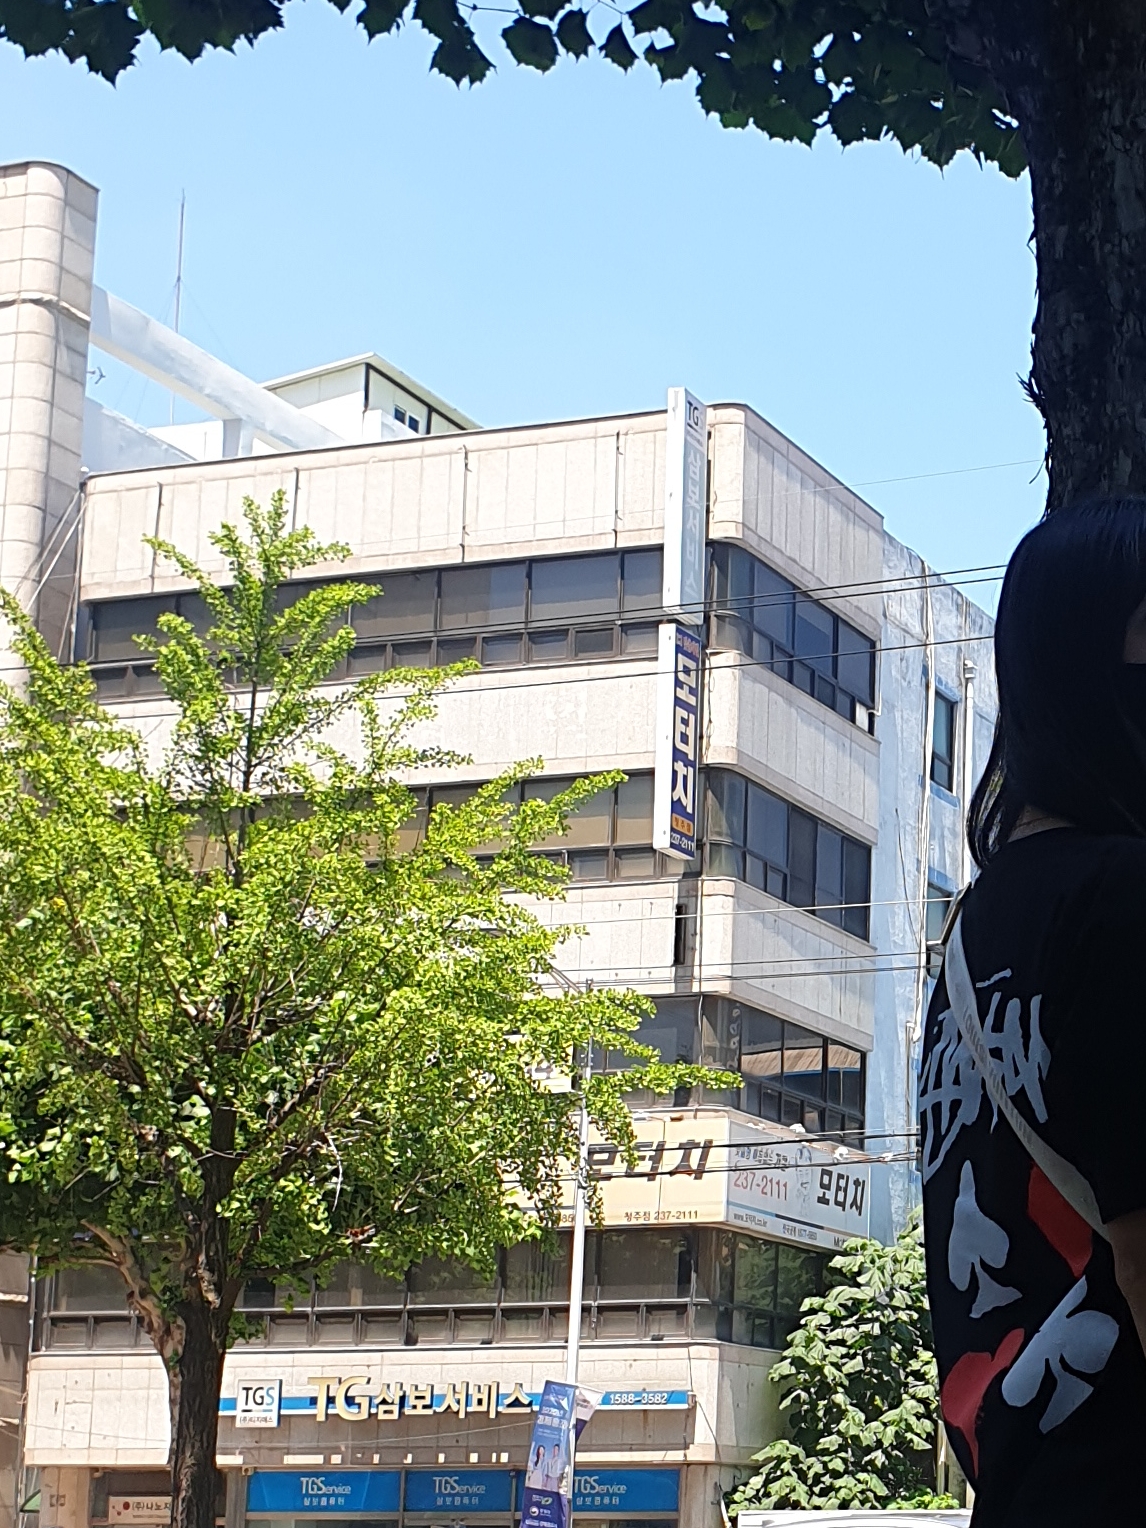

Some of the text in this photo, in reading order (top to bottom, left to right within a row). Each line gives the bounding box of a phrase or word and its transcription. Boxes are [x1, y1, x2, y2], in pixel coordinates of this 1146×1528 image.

[672, 652, 697, 814] 모터치
[671, 831, 694, 852] 237-2111
[733, 1170, 788, 1201] 237-2111
[816, 1168, 866, 1216] 모터치
[624, 1210, 698, 1223] 청주점 237-2111
[242, 1386, 275, 1406] TGS
[609, 1393, 668, 1405] 1588-3582
